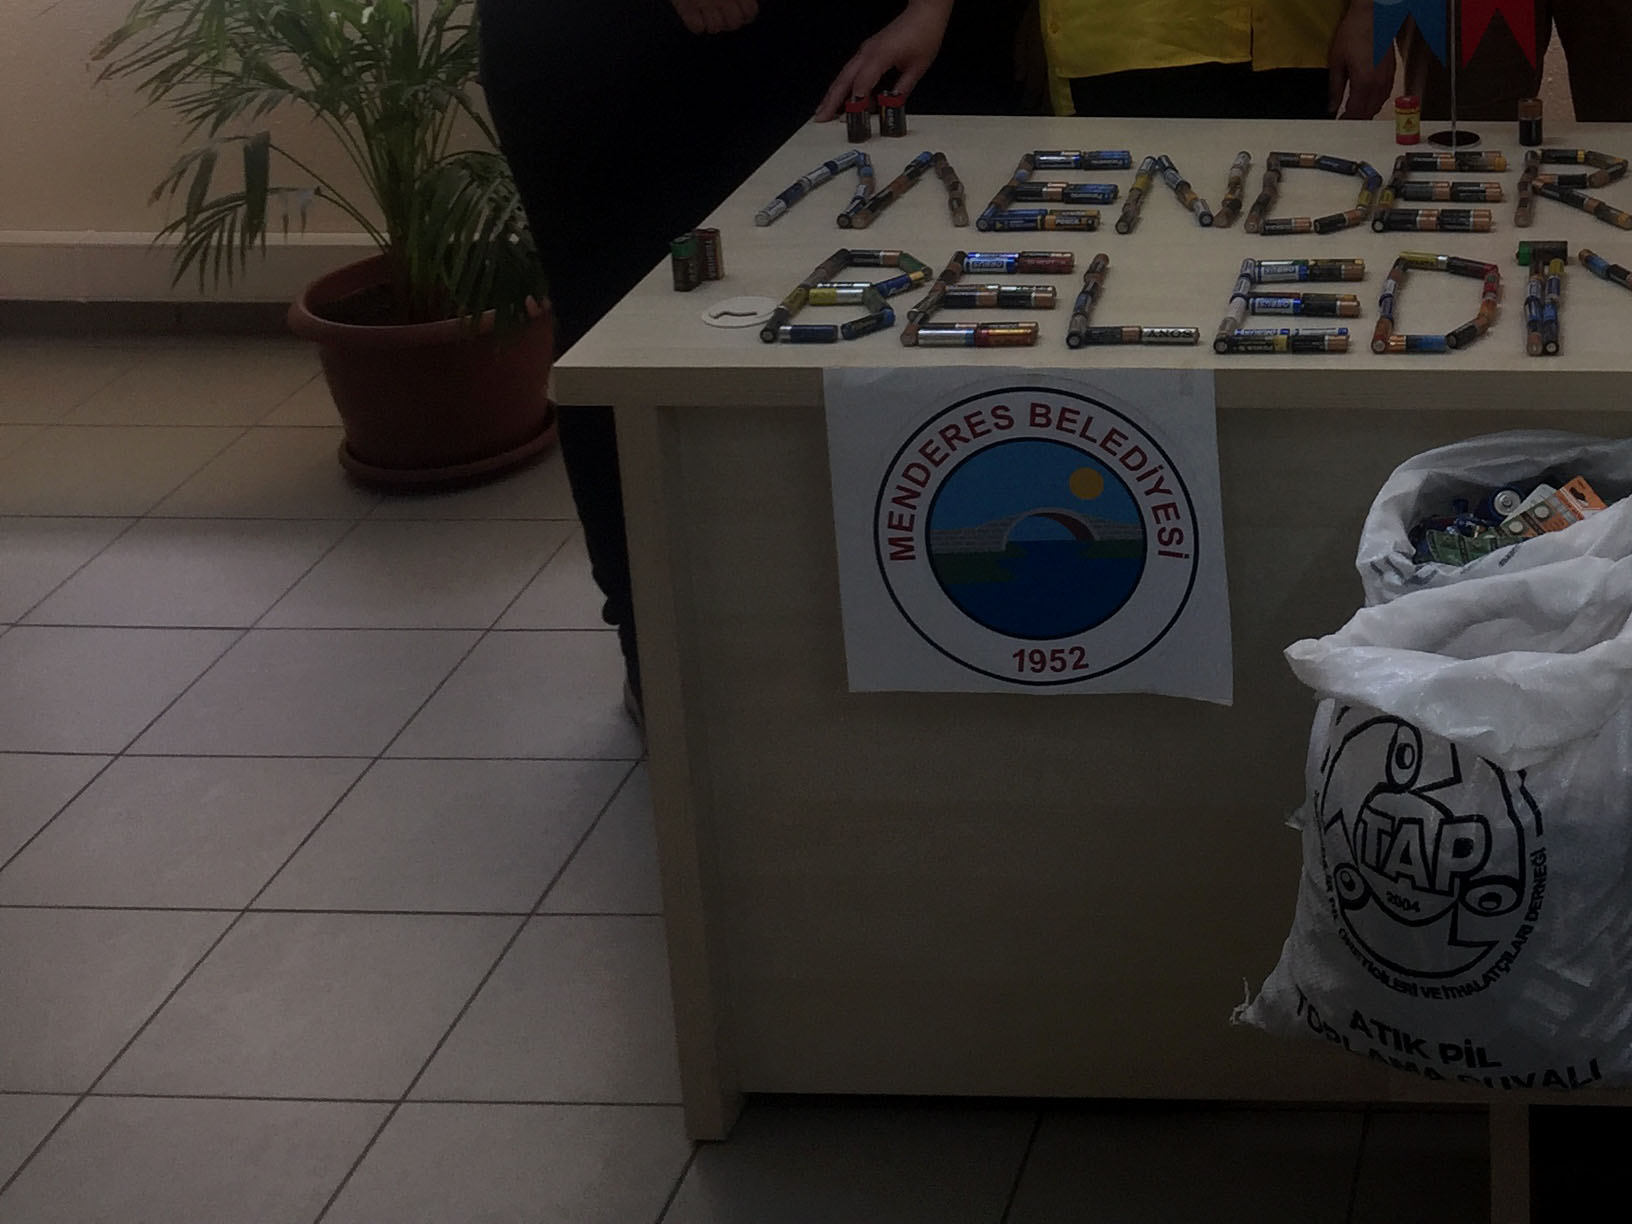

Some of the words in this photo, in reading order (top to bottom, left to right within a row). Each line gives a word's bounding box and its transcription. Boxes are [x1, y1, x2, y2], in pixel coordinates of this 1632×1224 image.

[1147, 329, 1193, 338] SONY
[887, 403, 1015, 563] MENDERES
[1029, 401, 1190, 560] BELEDİYESİ
[1012, 645, 1089, 674] 1952
[1355, 803, 1491, 897] TAP
[1349, 1009, 1431, 1060] ATIK
[1439, 1038, 1502, 1069] PİL
